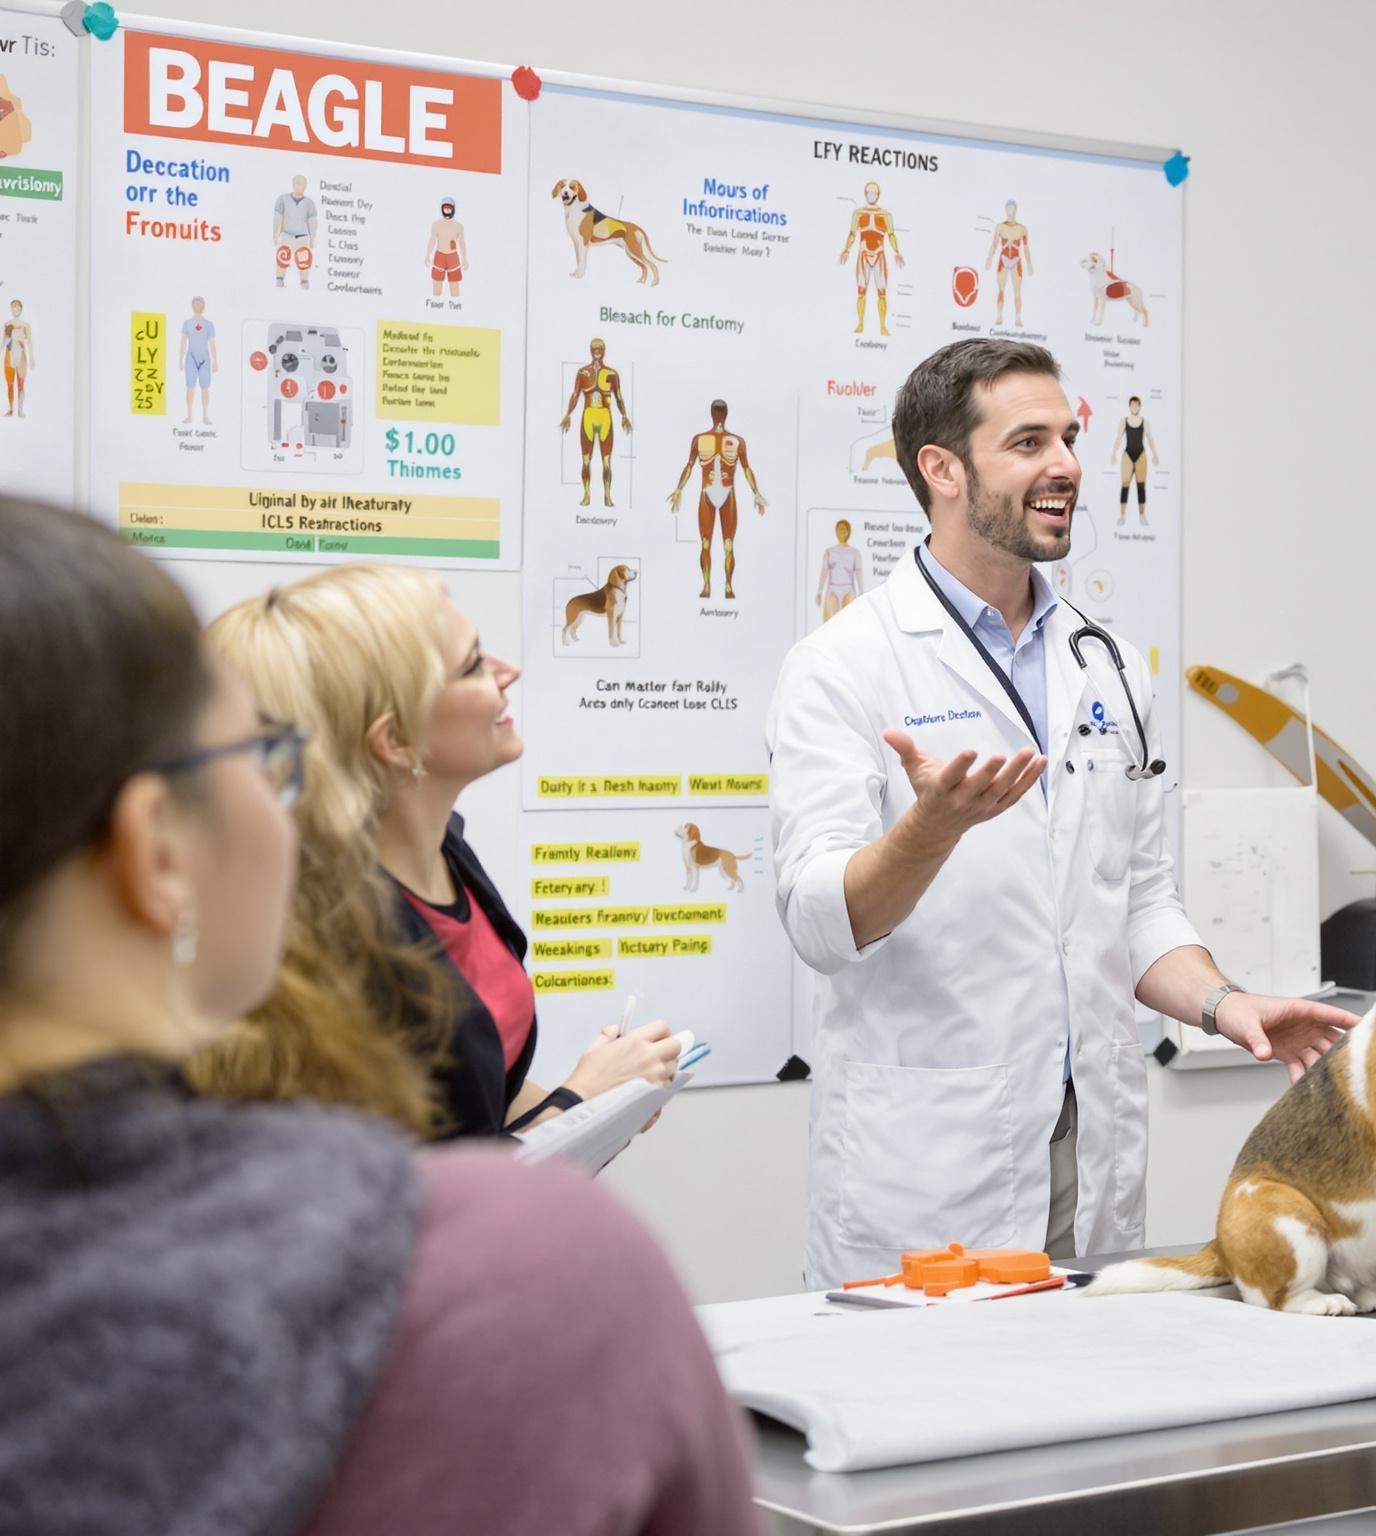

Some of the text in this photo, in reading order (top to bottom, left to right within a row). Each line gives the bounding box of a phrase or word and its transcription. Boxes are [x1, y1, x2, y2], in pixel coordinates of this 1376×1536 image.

[21, 35, 55, 56] Tis:
[148, 47, 454, 158] BEAGLE
[126, 149, 230, 183] Deccation
[848, 144, 938, 172] REACTIONS
[126, 185, 198, 207] orr the
[752, 184, 769, 201] of
[126, 210, 222, 242] Fronuits
[656, 310, 676, 327] for
[384, 426, 456, 456] $1.00
[262, 514, 294, 530] ICLS
[596, 679, 620, 692] Can
